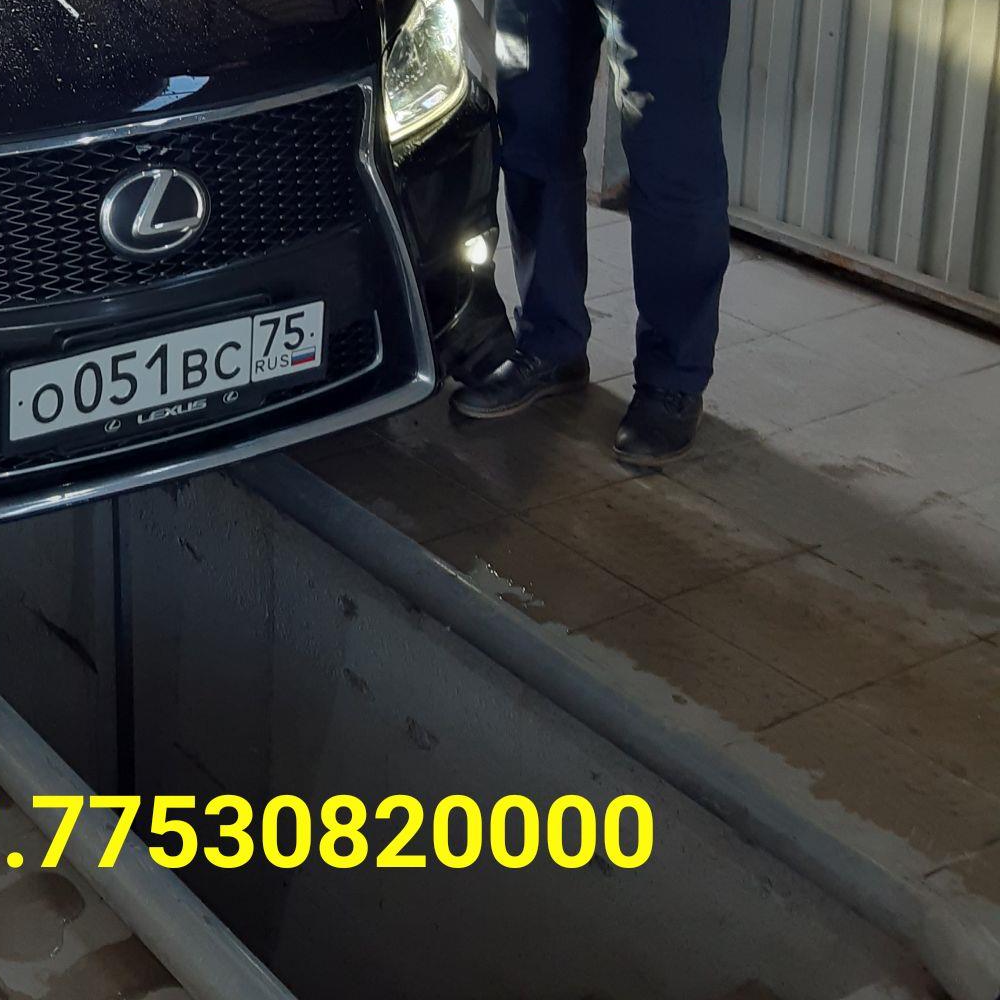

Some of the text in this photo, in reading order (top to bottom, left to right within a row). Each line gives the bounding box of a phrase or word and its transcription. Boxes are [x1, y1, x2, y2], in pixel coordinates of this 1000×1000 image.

[32, 311, 305, 424] О051ВС 75
[255, 354, 289, 375] RUS
[137, 399, 207, 424] LEXUS
